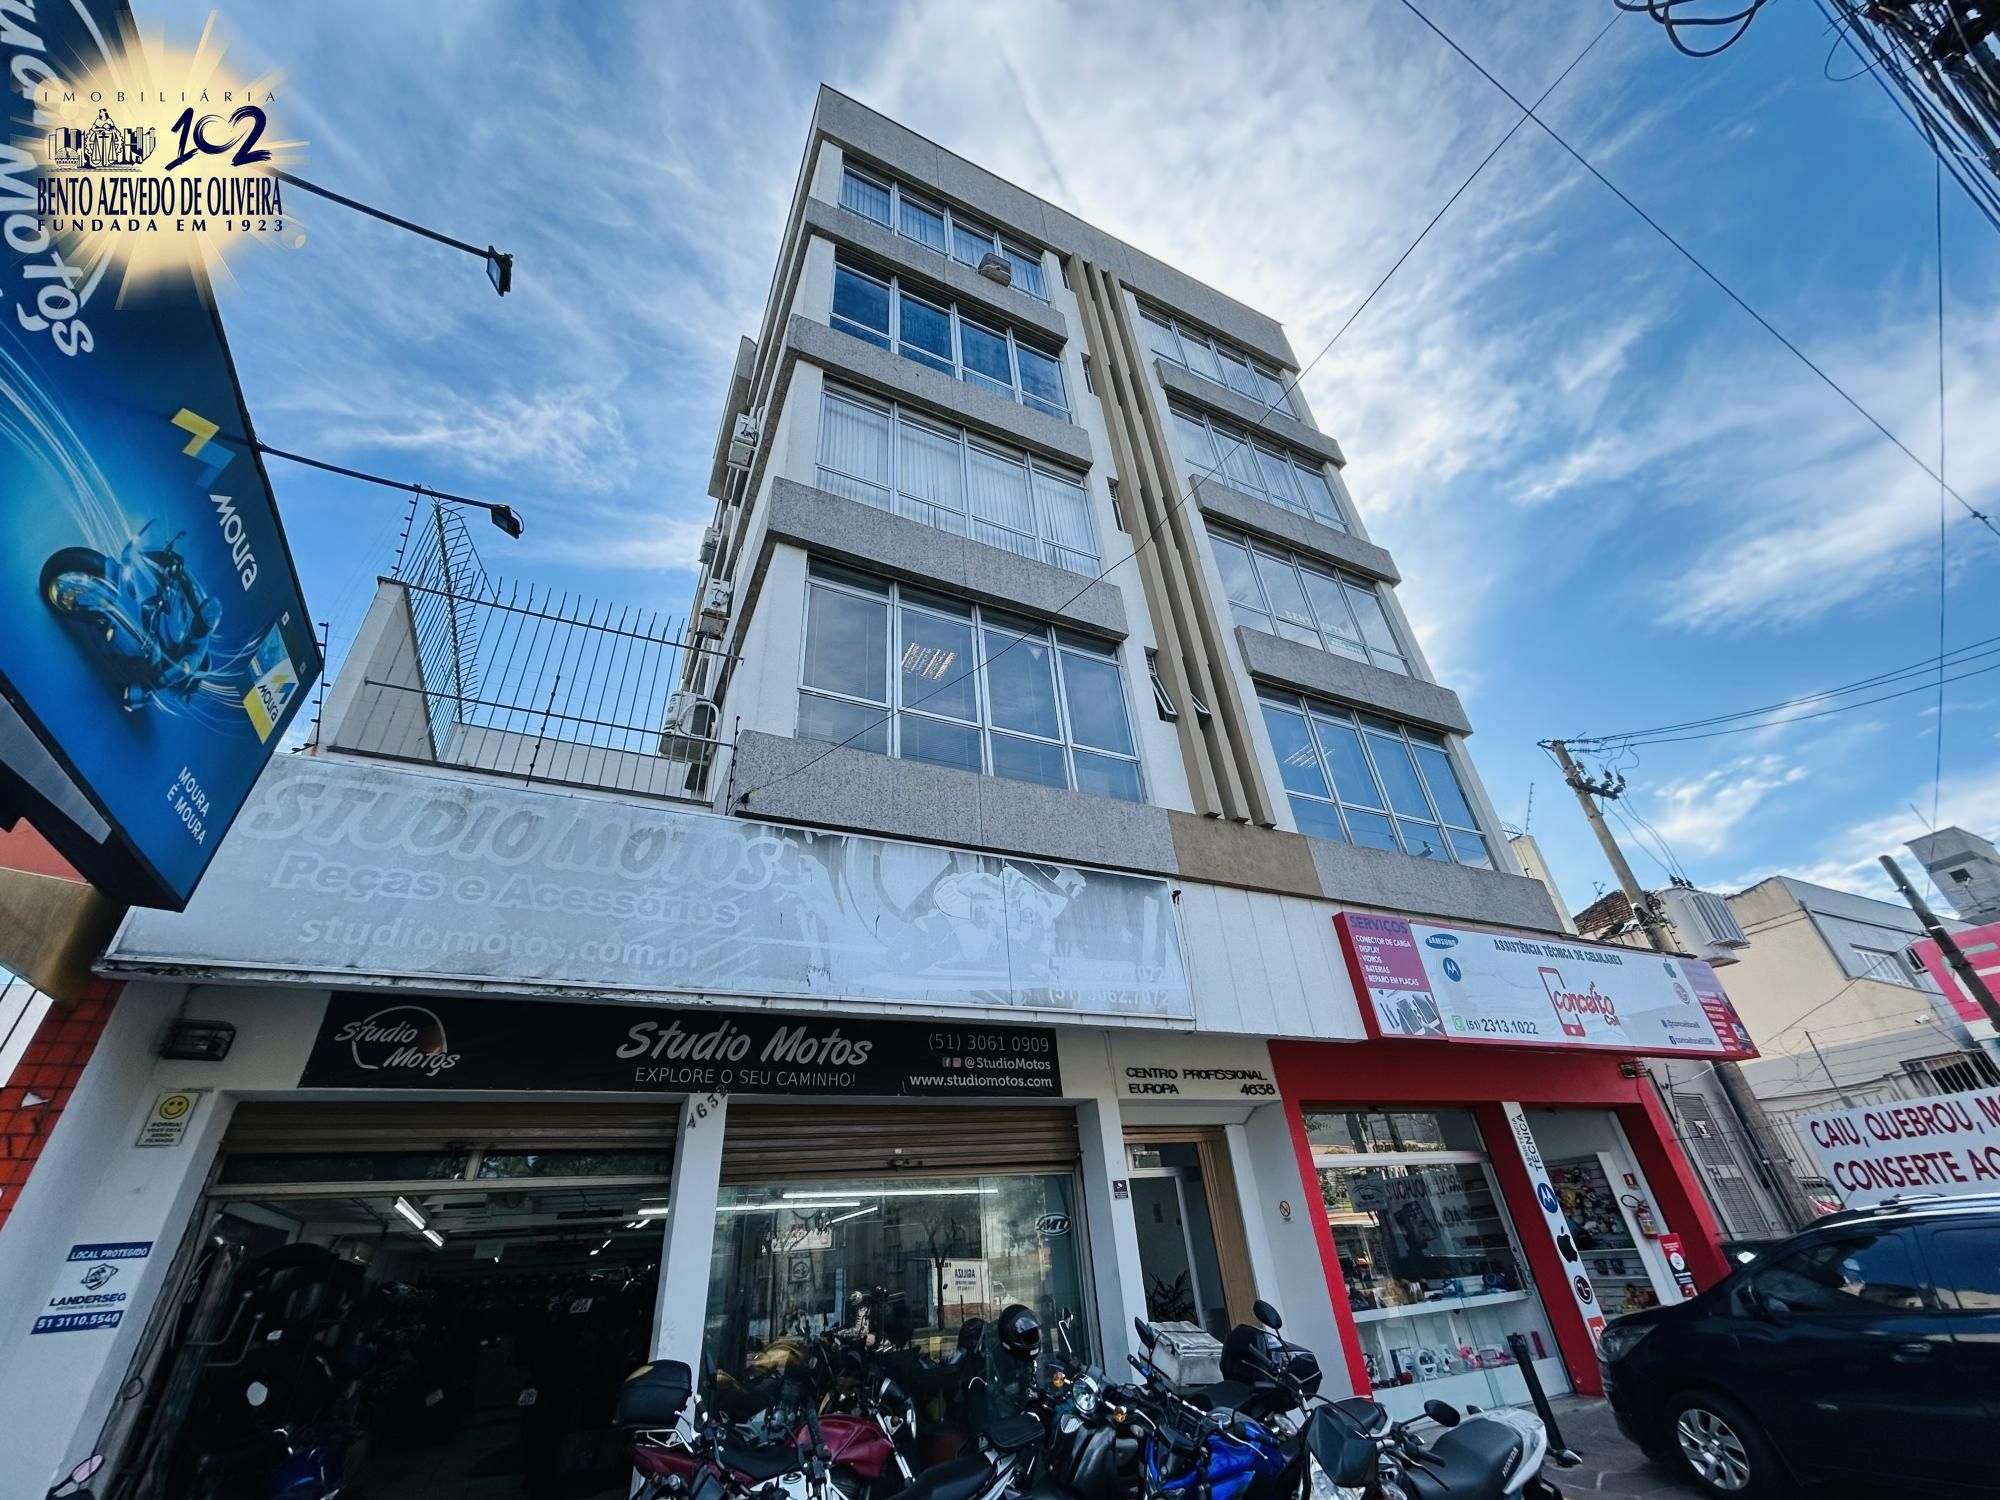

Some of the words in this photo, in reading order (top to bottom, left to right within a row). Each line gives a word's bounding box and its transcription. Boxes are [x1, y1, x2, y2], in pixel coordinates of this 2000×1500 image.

[178, 766, 211, 818] MOURA
[174, 795, 207, 845] MOURA
[269, 850, 448, 903] Peças
[1349, 916, 1409, 935] SERVIÇOS
[334, 1021, 418, 1043] Studio
[1465, 1019, 1480, 1030] (51)
[1481, 1018, 1539, 1034] 2313.1022
[616, 1019, 751, 1062] Studio
[760, 1025, 873, 1065] Motos
[928, 1033, 961, 1051] (51)
[967, 1034, 1006, 1051] 3061
[1011, 1036, 1049, 1053] 0909
[383, 1046, 461, 1076] Motos
[964, 1056, 1051, 1070] @StudioMotos
[635, 1067, 715, 1084] EXPLORE
[720, 1069, 733, 1084] O
[738, 1069, 771, 1085] SEU
[776, 1071, 856, 1087] CAMINHO!
[909, 1074, 1053, 1088] www.studiomotos.com
[1126, 1067, 1178, 1079] CENTRO
[1183, 1068, 1268, 1081] PROFISSIONAL
[1129, 1083, 1180, 1095] EUROPA
[1240, 1083, 1276, 1096] 4638
[1810, 1116, 1870, 1148] CAIU,
[1974, 1093, 2000, 1128] M
[1833, 1151, 1969, 1192] CONSERTE
[70, 1250, 98, 1260] LOCAL
[100, 1247, 148, 1257] PROTEGIDO
[49, 1292, 127, 1306] LANDERSEG
[37, 1319, 53, 1329] 51
[56, 1313, 120, 1328] 3110.5540
